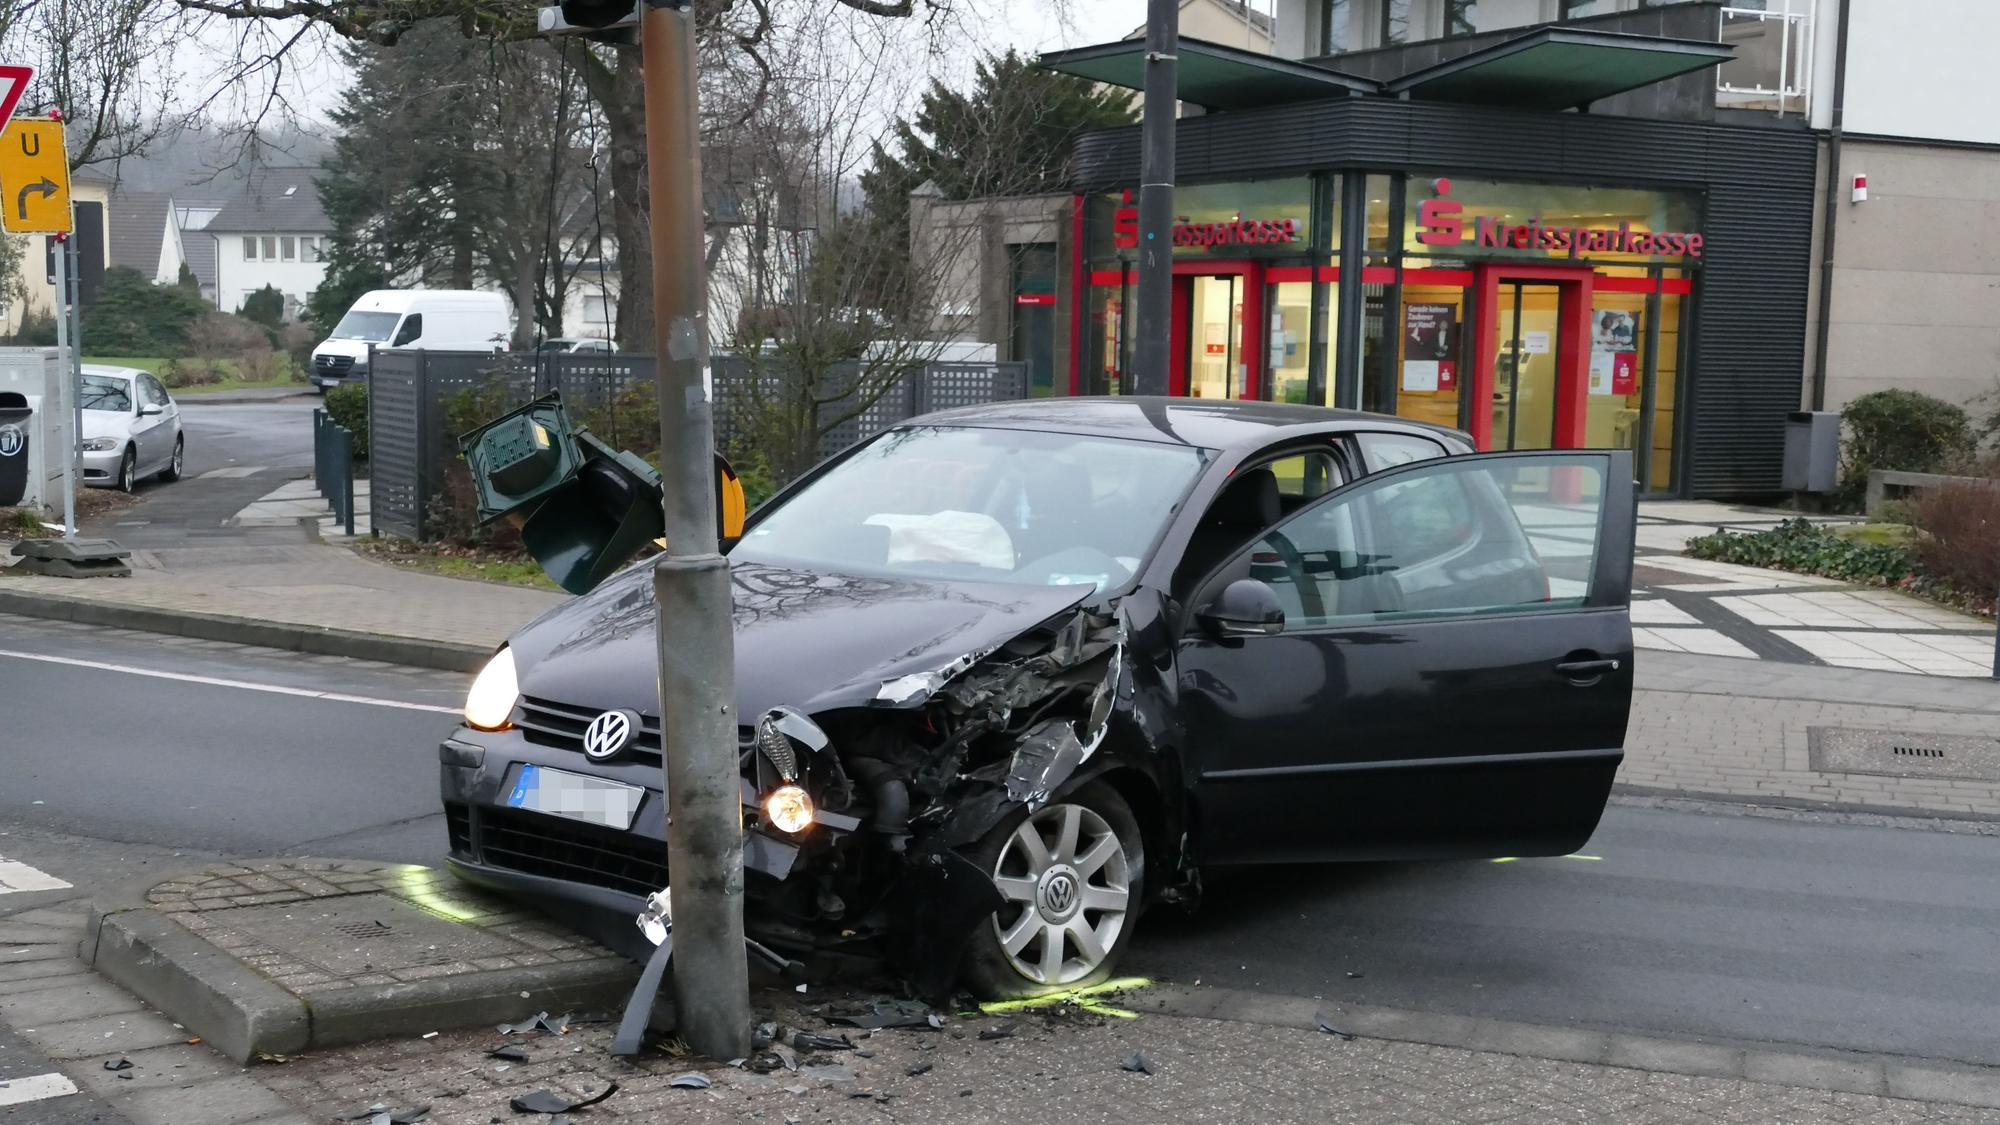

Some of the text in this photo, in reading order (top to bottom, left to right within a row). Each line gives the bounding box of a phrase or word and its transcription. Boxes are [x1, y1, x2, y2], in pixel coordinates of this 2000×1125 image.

[21, 133, 40, 156] U
[1172, 211, 1296, 253] issparkasse
[1474, 215, 1704, 258] Kreissparkasse
